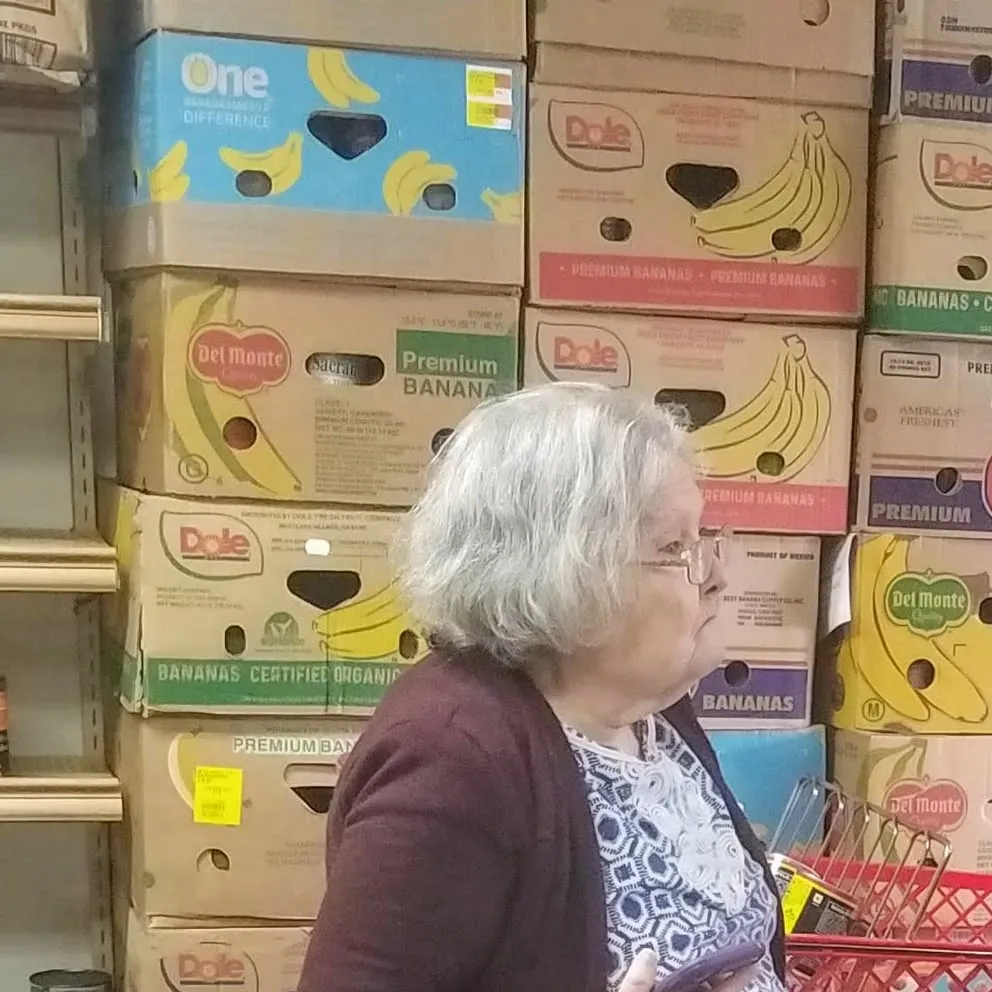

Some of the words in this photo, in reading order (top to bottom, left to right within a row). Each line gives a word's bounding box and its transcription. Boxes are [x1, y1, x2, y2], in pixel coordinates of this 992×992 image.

[181, 52, 270, 99] One
[183, 109, 272, 130] DIFFERENCE
[565, 114, 632, 144] Dole
[571, 264, 631, 278] PREMIUM
[633, 268, 693, 283] BANANAS
[710, 269, 768, 285] PREMIUM
[769, 273, 826, 288] BANANAS
[896, 289, 970, 311] BANANAS
[198, 343, 226, 364] Del
[229, 346, 285, 369] Monte
[554, 336, 619, 367] Dole
[401, 350, 498, 376] Premium
[755, 491, 814, 507] BANANAS
[871, 502, 972, 524] PREMIUM
[180, 526, 251, 555] Dole
[891, 590, 917, 609] Del
[918, 591, 967, 609] Monte
[158, 663, 241, 684] BANANAS
[702, 693, 795, 713] BANANAS
[233, 736, 317, 754] PREMIUM
[890, 797, 913, 814] Del
[915, 796, 962, 814] Monte
[177, 953, 245, 980] Dole
